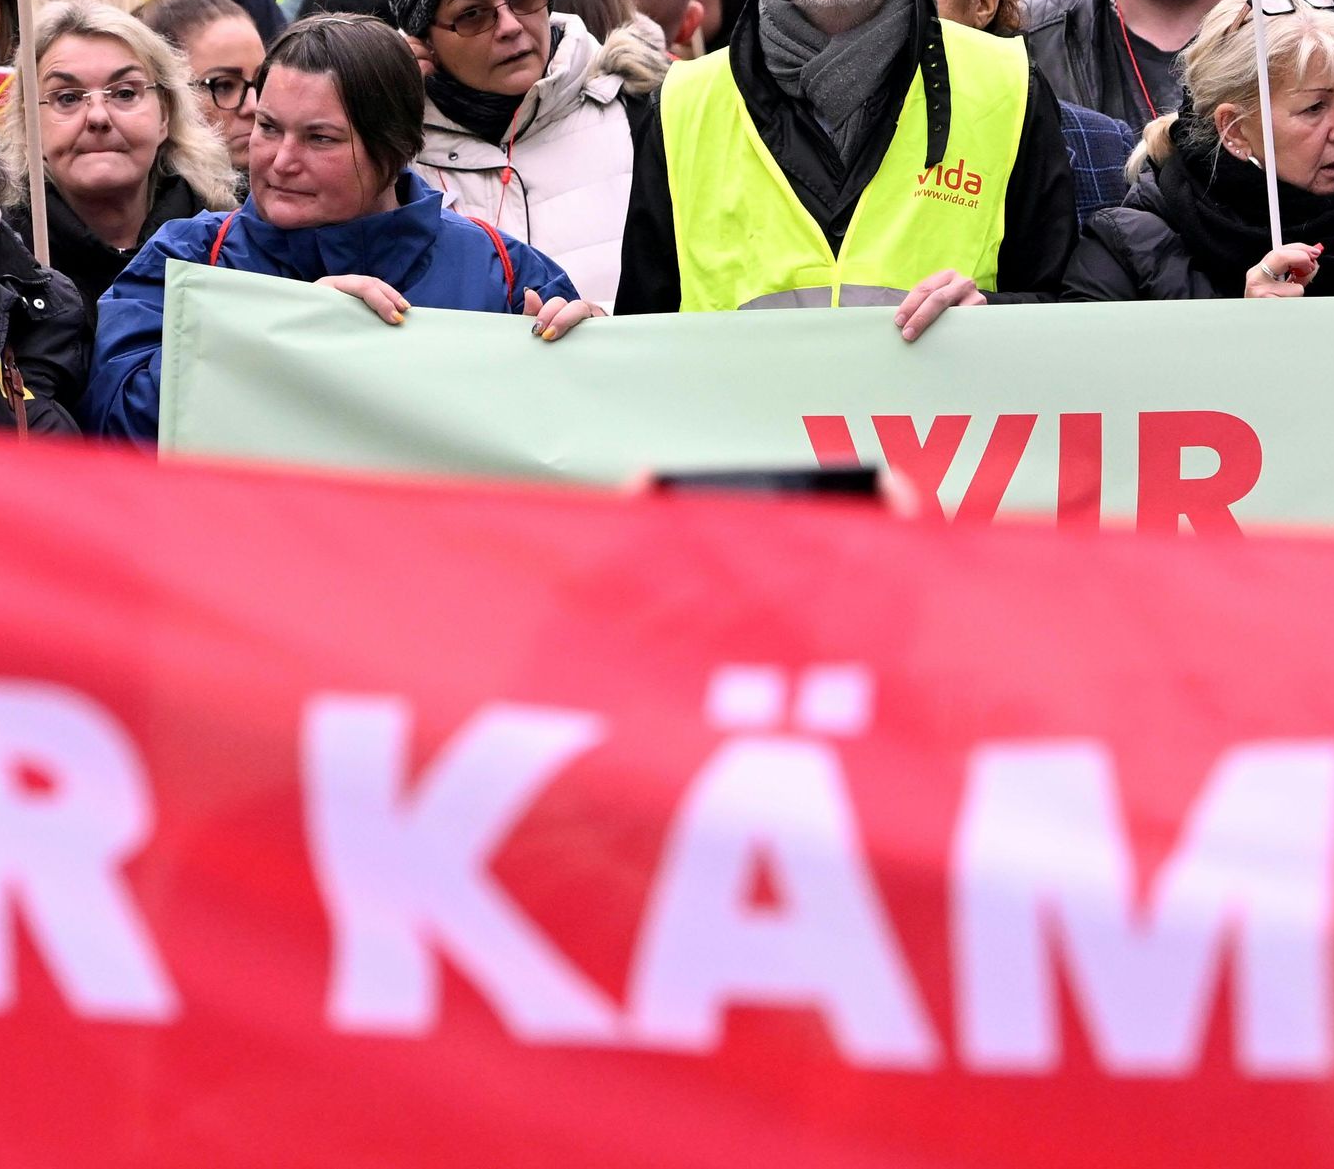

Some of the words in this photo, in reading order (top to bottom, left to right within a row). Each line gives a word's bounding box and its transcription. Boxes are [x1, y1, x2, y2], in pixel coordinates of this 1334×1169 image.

[917, 159, 982, 195] vida
[914, 189, 980, 209] www.vida.at
[802, 409, 1266, 538] WIR
